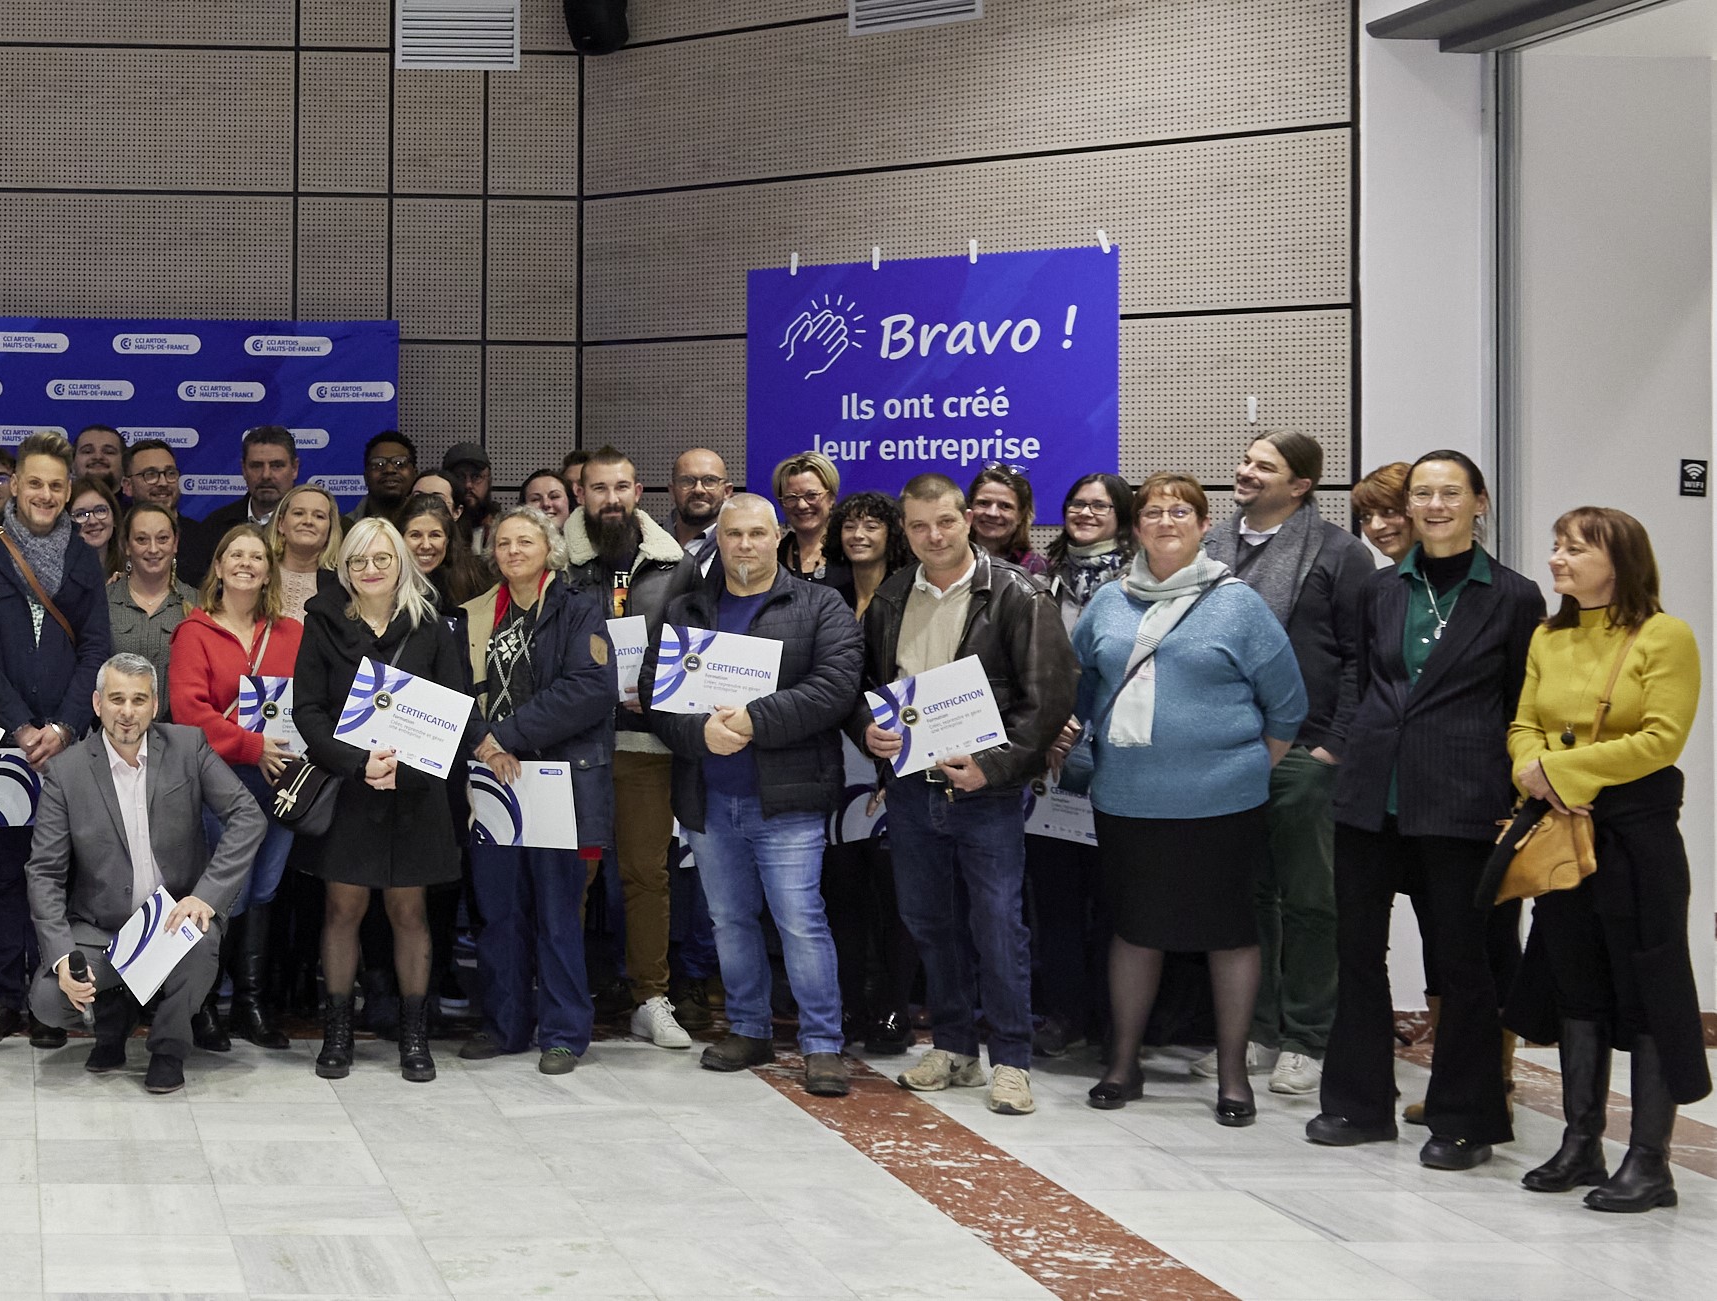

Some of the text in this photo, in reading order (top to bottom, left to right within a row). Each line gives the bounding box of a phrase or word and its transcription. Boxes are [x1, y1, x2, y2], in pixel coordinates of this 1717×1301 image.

[880, 305, 1078, 360] Bravo !
[2, 335, 36, 343] CCI ARTOIS
[2, 341, 59, 349] HAUTS-DE-FRANCE
[134, 343, 191, 351] HAUTS-DE-FRANCE
[266, 345, 323, 353] HAUTS-DE-FRANCE
[67, 382, 101, 390] CCI ARTOIS
[199, 384, 233, 392] CCI ARTOIS
[67, 389, 124, 397] HAUTS-DE-FRANCE
[199, 391, 256, 399] HAUTS-DE-FRANCE
[330, 391, 387, 399] HAUTS-DE-FRANCE
[841, 386, 1010, 420] Ils ont créé
[813, 428, 1041, 467] leur entreprise
[706, 662, 771, 679] CERTIFICATION
[923, 688, 984, 715] CERTIFICATION
[396, 703, 458, 732] CERTIFICATION
